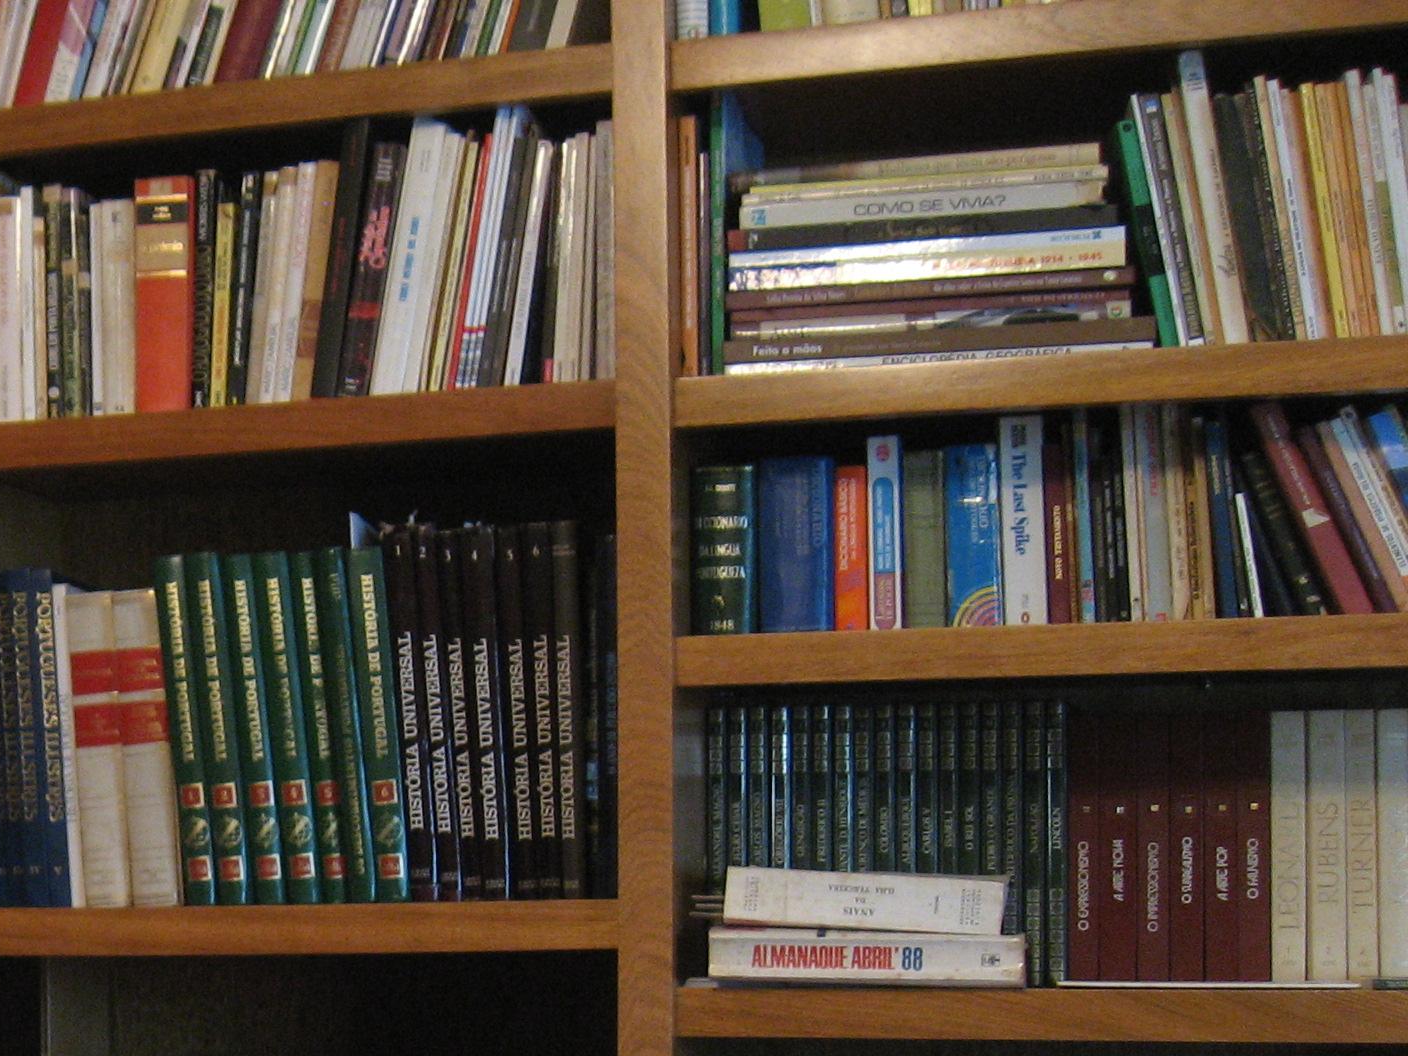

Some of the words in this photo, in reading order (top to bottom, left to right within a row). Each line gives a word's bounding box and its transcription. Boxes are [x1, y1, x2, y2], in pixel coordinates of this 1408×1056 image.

[854, 201, 913, 216] COMO
[920, 199, 942, 213] SE
[950, 195, 1006, 210] VIVIA?
[753, 345, 779, 356] Feito
[793, 343, 822, 354] mãos
[1011, 454, 1026, 480] The
[1012, 484, 1027, 512] Last
[1011, 517, 1030, 555] Spike
[1053, 505, 1062, 557] TESTAMENTO
[1054, 558, 1062, 579] NOVO
[173, 655, 188, 678] DE
[205, 655, 220, 678] DE
[241, 655, 255, 677] DE
[274, 653, 288, 675] DE
[308, 654, 322, 676] DE
[367, 651, 381, 673] DE
[396, 631, 418, 739] UNIVERSAL
[423, 634, 444, 741] UNIVERSAL
[448, 638, 469, 746] UNIVERSAL
[473, 638, 493, 748] UNIVERSAL
[508, 638, 528, 748] UNIVERSAL
[533, 634, 552, 745] UNIVERSAL
[556, 635, 573, 746] UNIVERSAL
[175, 680, 195, 763] PORTUGAL
[207, 679, 227, 763] PORTUGAL
[245, 678, 264, 763] PORTUGAL
[370, 675, 388, 759] PORTUGAL
[404, 742, 424, 831] HISTÓRIA
[432, 744, 451, 833] HISTÓRIA
[456, 750, 474, 838] HISTÓRIA
[479, 751, 499, 841] HISTÓRIA
[513, 752, 533, 841] HISTÓRIA
[537, 749, 556, 838] HISTÓRIA
[560, 750, 576, 840] HISTÓRIA
[1052, 807, 1062, 850] LINCOLN
[1316, 802, 1338, 904] RUBENS
[1217, 846, 1228, 867] POP
[1351, 799, 1373, 913] TURNER
[843, 907, 875, 916] ANAIS
[1181, 894, 1193, 904] O
[1247, 888, 1259, 899] O
[1077, 920, 1089, 931] O
[1147, 922, 1159, 932] O
[752, 944, 848, 969] ALMANAQUE
